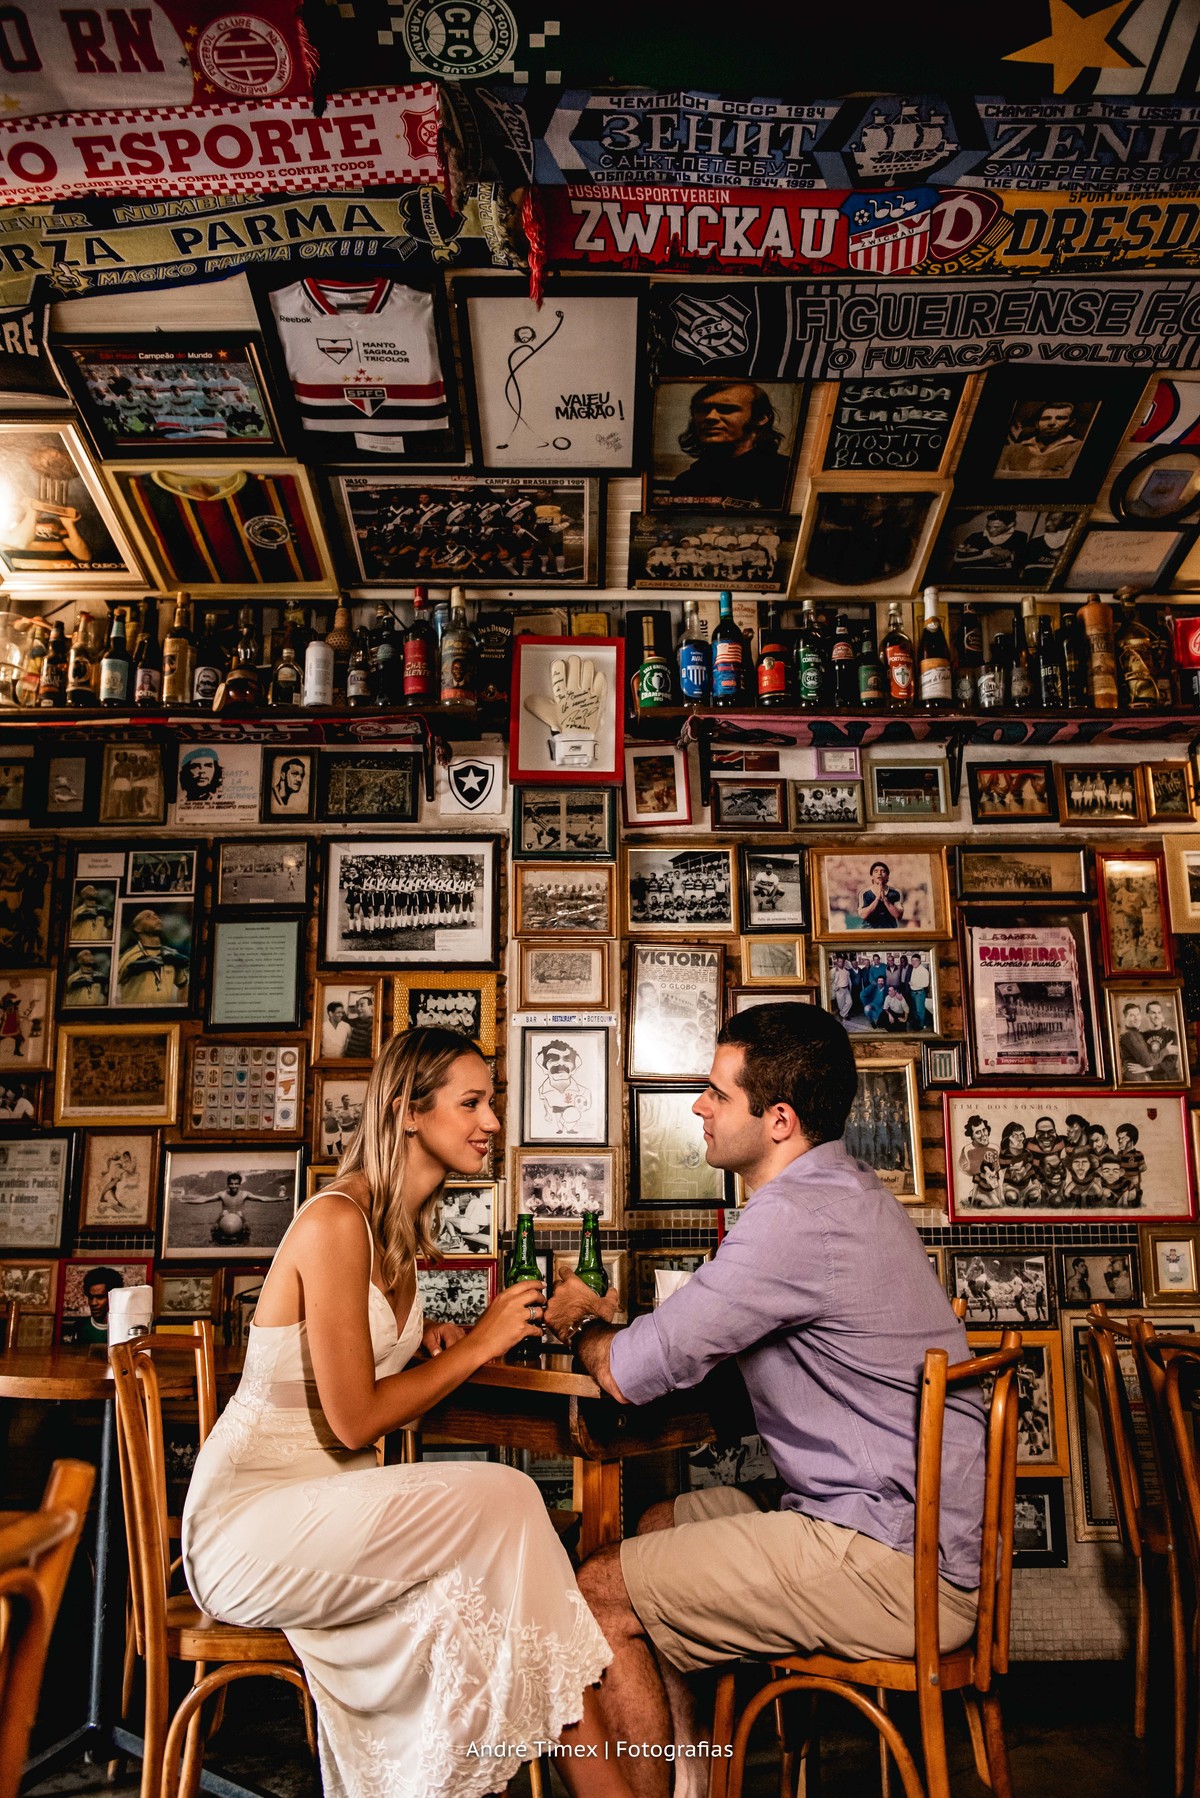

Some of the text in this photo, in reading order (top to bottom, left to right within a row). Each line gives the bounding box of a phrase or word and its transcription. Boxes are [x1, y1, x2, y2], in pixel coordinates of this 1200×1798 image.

[217, 19, 252, 31] CLUBE
[444, 7, 474, 59] CFC
[59, 8, 165, 73] RN
[409, 8, 430, 60] PARANÁ
[442, 65, 477, 75] CLUB
[609, 95, 826, 118] ЧЕМПИОН СССР 1984
[984, 104, 1066, 118] CHAMPION
[1073, 103, 1094, 117] OF
[1101, 105, 1131, 118] THE
[601, 113, 817, 161] ЗЕНИТ
[72, 113, 383, 179] ESPORTE
[600, 154, 812, 177] САНКТ-ПЕТЕРБУРГ
[73, 180, 113, 189] CLUBE
[114, 178, 133, 186] DO
[135, 177, 169, 185] POVO
[178, 173, 227, 183] CONTRA
[230, 170, 265, 181] TUDO
[266, 169, 276, 178] E
[278, 165, 329, 178] CONTRA
[331, 160, 375, 172] TODOS
[696, 173, 742, 185] КУБКА
[983, 178, 1012, 189] THE
[1016, 179, 1049, 190] CUP
[1057, 180, 1119, 192] WINNER
[567, 184, 731, 204] FUSSBALLSPORTVEREIN
[421, 192, 433, 220] PARMA
[169, 203, 385, 256] PARMA
[569, 200, 842, 260] ZWICKAU
[860, 228, 916, 248] ZWICKAU
[97, 262, 197, 287] MAGICO
[204, 245, 291, 273] PARMA
[299, 240, 338, 259] OK
[279, 314, 312, 324] Reebok
[795, 287, 1138, 341] FIGUEIRENSE
[362, 341, 396, 349] MANTO
[363, 348, 408, 357] SAGRADO
[138, 351, 175, 361] Campeão
[187, 351, 213, 360] Mundo
[364, 355, 410, 364] TRICOLOR
[827, 338, 1181, 370] O FURACÃO VOLTOU
[347, 389, 385, 398] SPFC
[560, 391, 610, 407] VALEU
[555, 404, 616, 420] MAGRÃO
[834, 431, 943, 450] MOJITO
[830, 449, 919, 468] BLOOD
[484, 478, 521, 486] CAMPEÃO
[522, 478, 565, 486] BRASILEIRO
[80, 562, 91, 570] DE
[746, 583, 776, 591] 2000
[198, 730, 292, 743] 2016
[637, 951, 718, 968] VICTORIA
[979, 945, 1067, 961] PALMEIRAS
[1030, 960, 1061, 968] mundo
[551, 1015, 577, 1023] RESTAURANTE
[587, 1015, 613, 1023] BOTEQUIM
